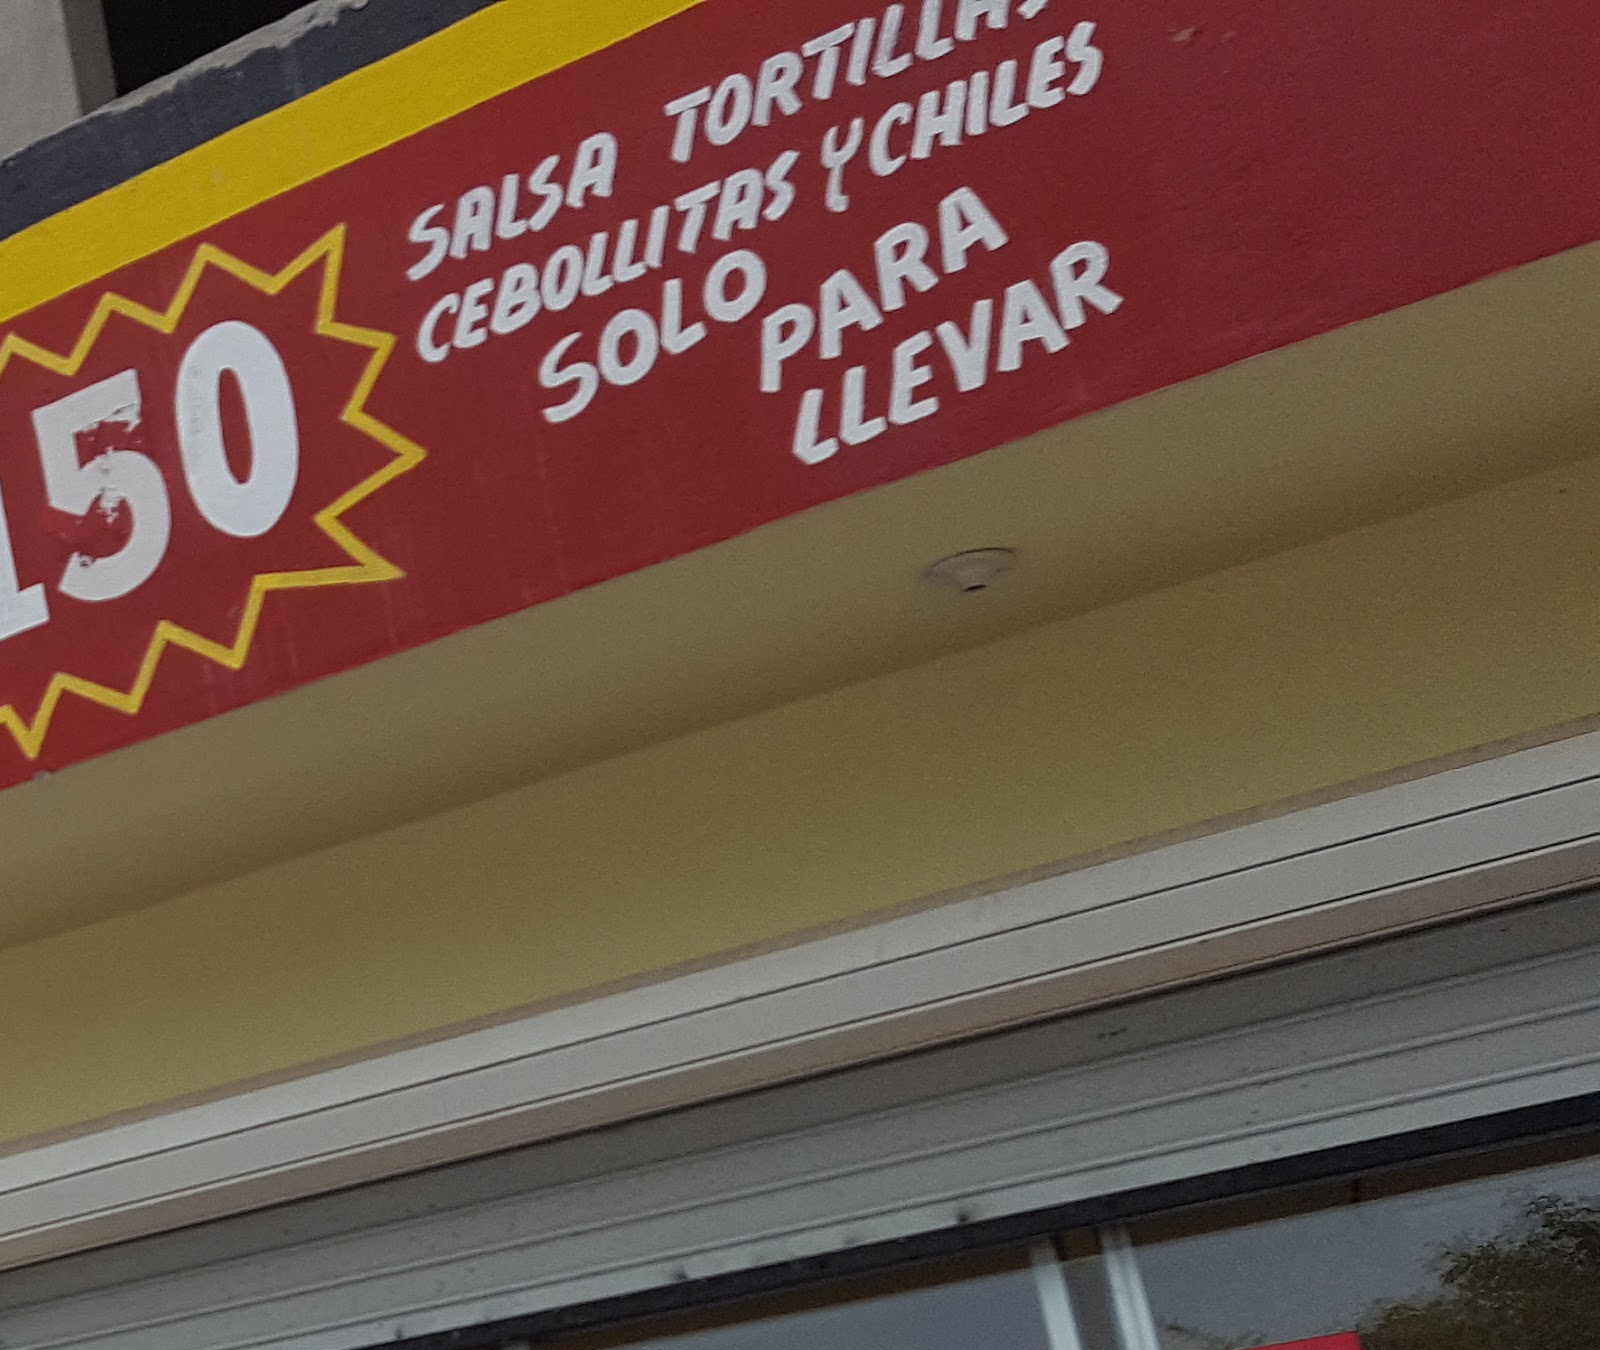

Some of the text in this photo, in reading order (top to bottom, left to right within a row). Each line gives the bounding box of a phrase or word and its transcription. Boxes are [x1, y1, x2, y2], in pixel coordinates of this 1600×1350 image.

[406, 0, 1047, 282] SALSA TORTILLA
[415, 21, 1103, 365] CEBOLLITAS Y CHILES
[538, 249, 767, 425] SOLO
[759, 186, 1009, 394] PARA
[791, 240, 1124, 466] LLEVAR
